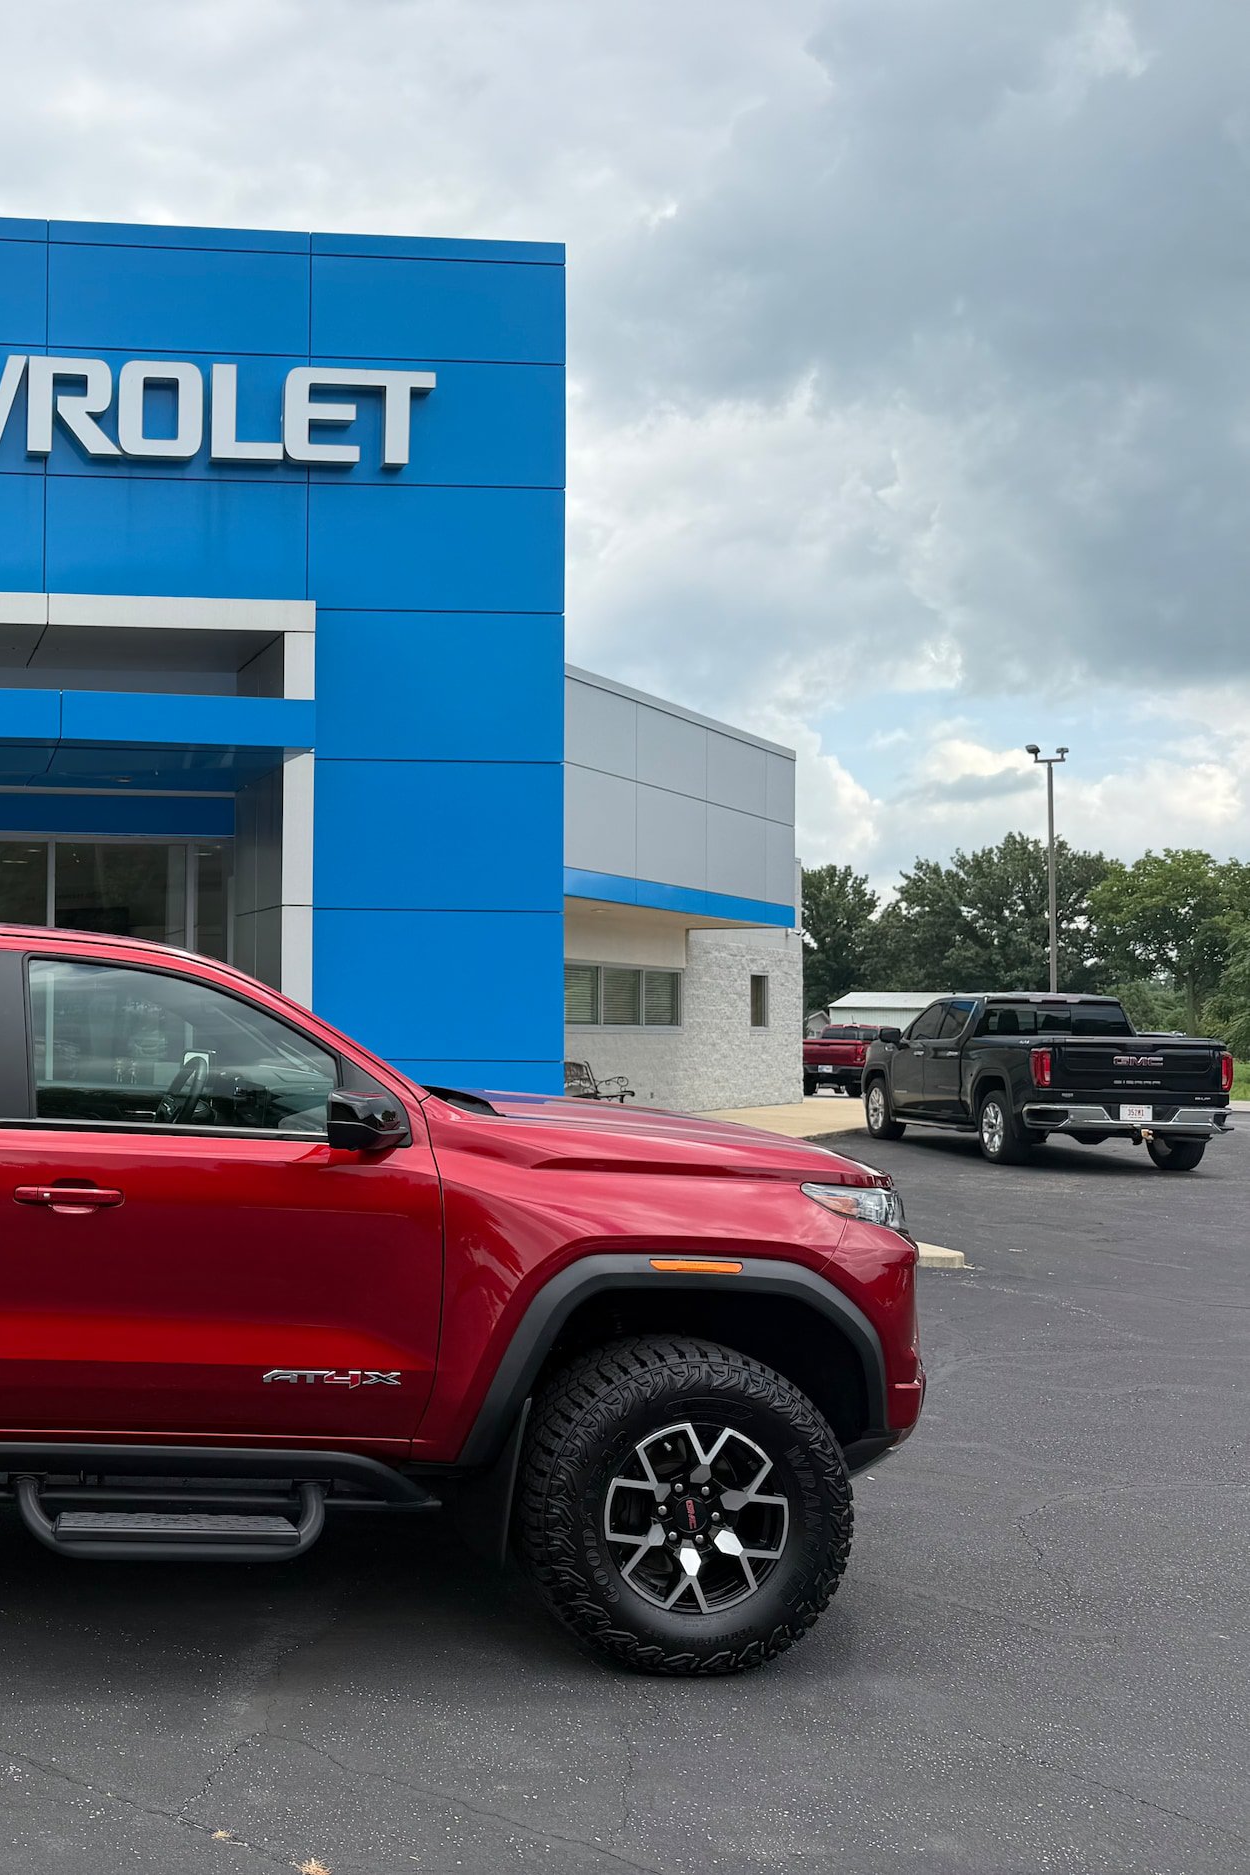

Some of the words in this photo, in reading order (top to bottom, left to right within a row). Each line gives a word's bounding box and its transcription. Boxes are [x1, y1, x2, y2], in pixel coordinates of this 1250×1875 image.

[1113, 1055, 1163, 1066] GMC
[263, 1369, 401, 1389] AT4X
[685, 1499, 697, 1530] GMC
